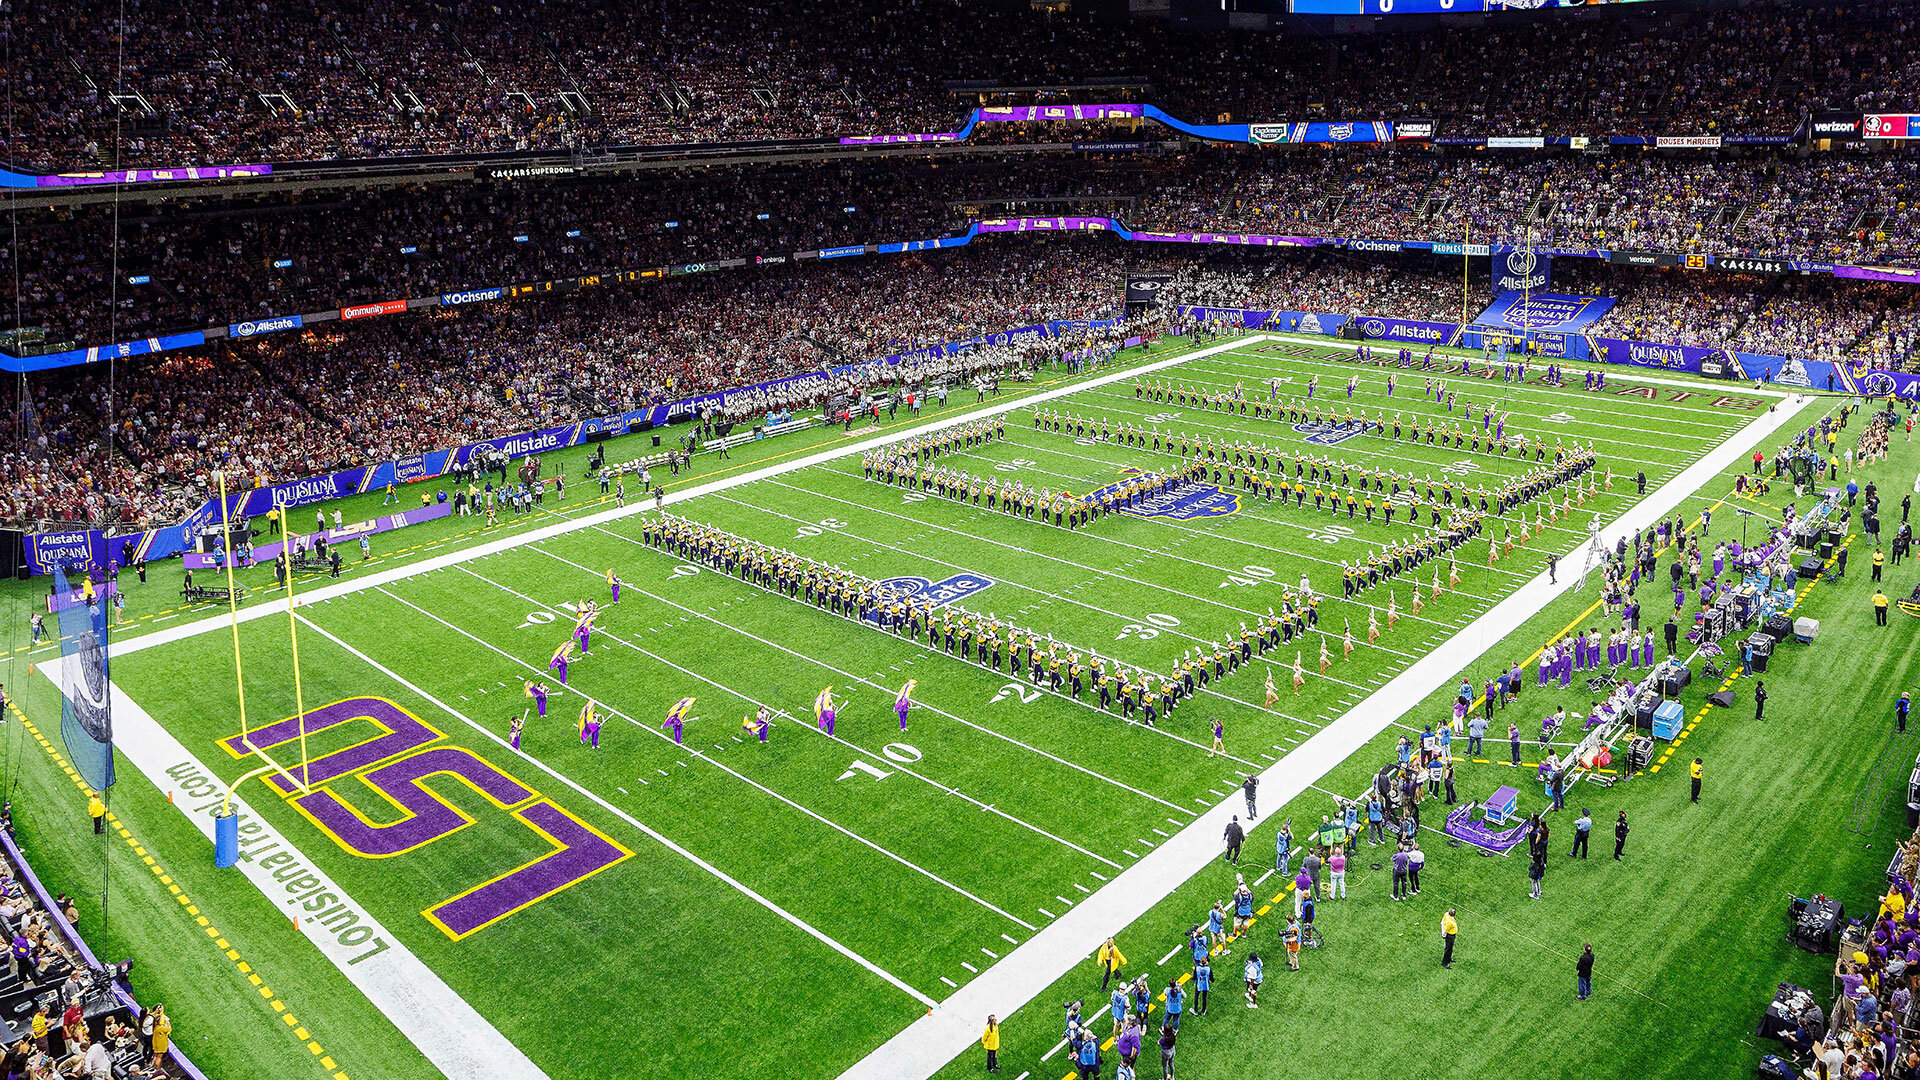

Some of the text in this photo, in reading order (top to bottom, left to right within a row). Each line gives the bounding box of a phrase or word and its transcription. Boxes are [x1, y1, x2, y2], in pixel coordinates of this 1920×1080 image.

[1045, 107, 1065, 117] LSU
[1815, 123, 1854, 132] verizon
[1883, 122, 1891, 132] 0
[1658, 137, 1719, 146] ROUSES MARKETS
[1034, 220, 1052, 228] LSU
[1356, 240, 1401, 251] Ochsner
[1434, 244, 1462, 253] PEOPLES
[1688, 255, 1703, 267] 25
[1720, 260, 1781, 273] CAESARS
[685, 263, 707, 273] COX
[546, 282, 551, 291] 0
[1498, 275, 1546, 290] Allstate
[451, 289, 500, 304] Ochsner
[344, 304, 384, 319] Community
[1520, 301, 1577, 311] Allstate
[256, 318, 294, 333] Allstate
[1389, 325, 1437, 339] Allstate
[501, 434, 561, 455] Allstate
[397, 457, 423, 467] Allstate
[271, 475, 339, 508] LOUISIANA
[40, 534, 85, 546] Allstate
[1307, 525, 1355, 544] 50
[39, 545, 90, 564] LOUISIANA
[1227, 565, 1277, 587] 40
[1122, 613, 1181, 640] 30
[848, 743, 923, 782] 10
[215, 695, 637, 942] LSU
